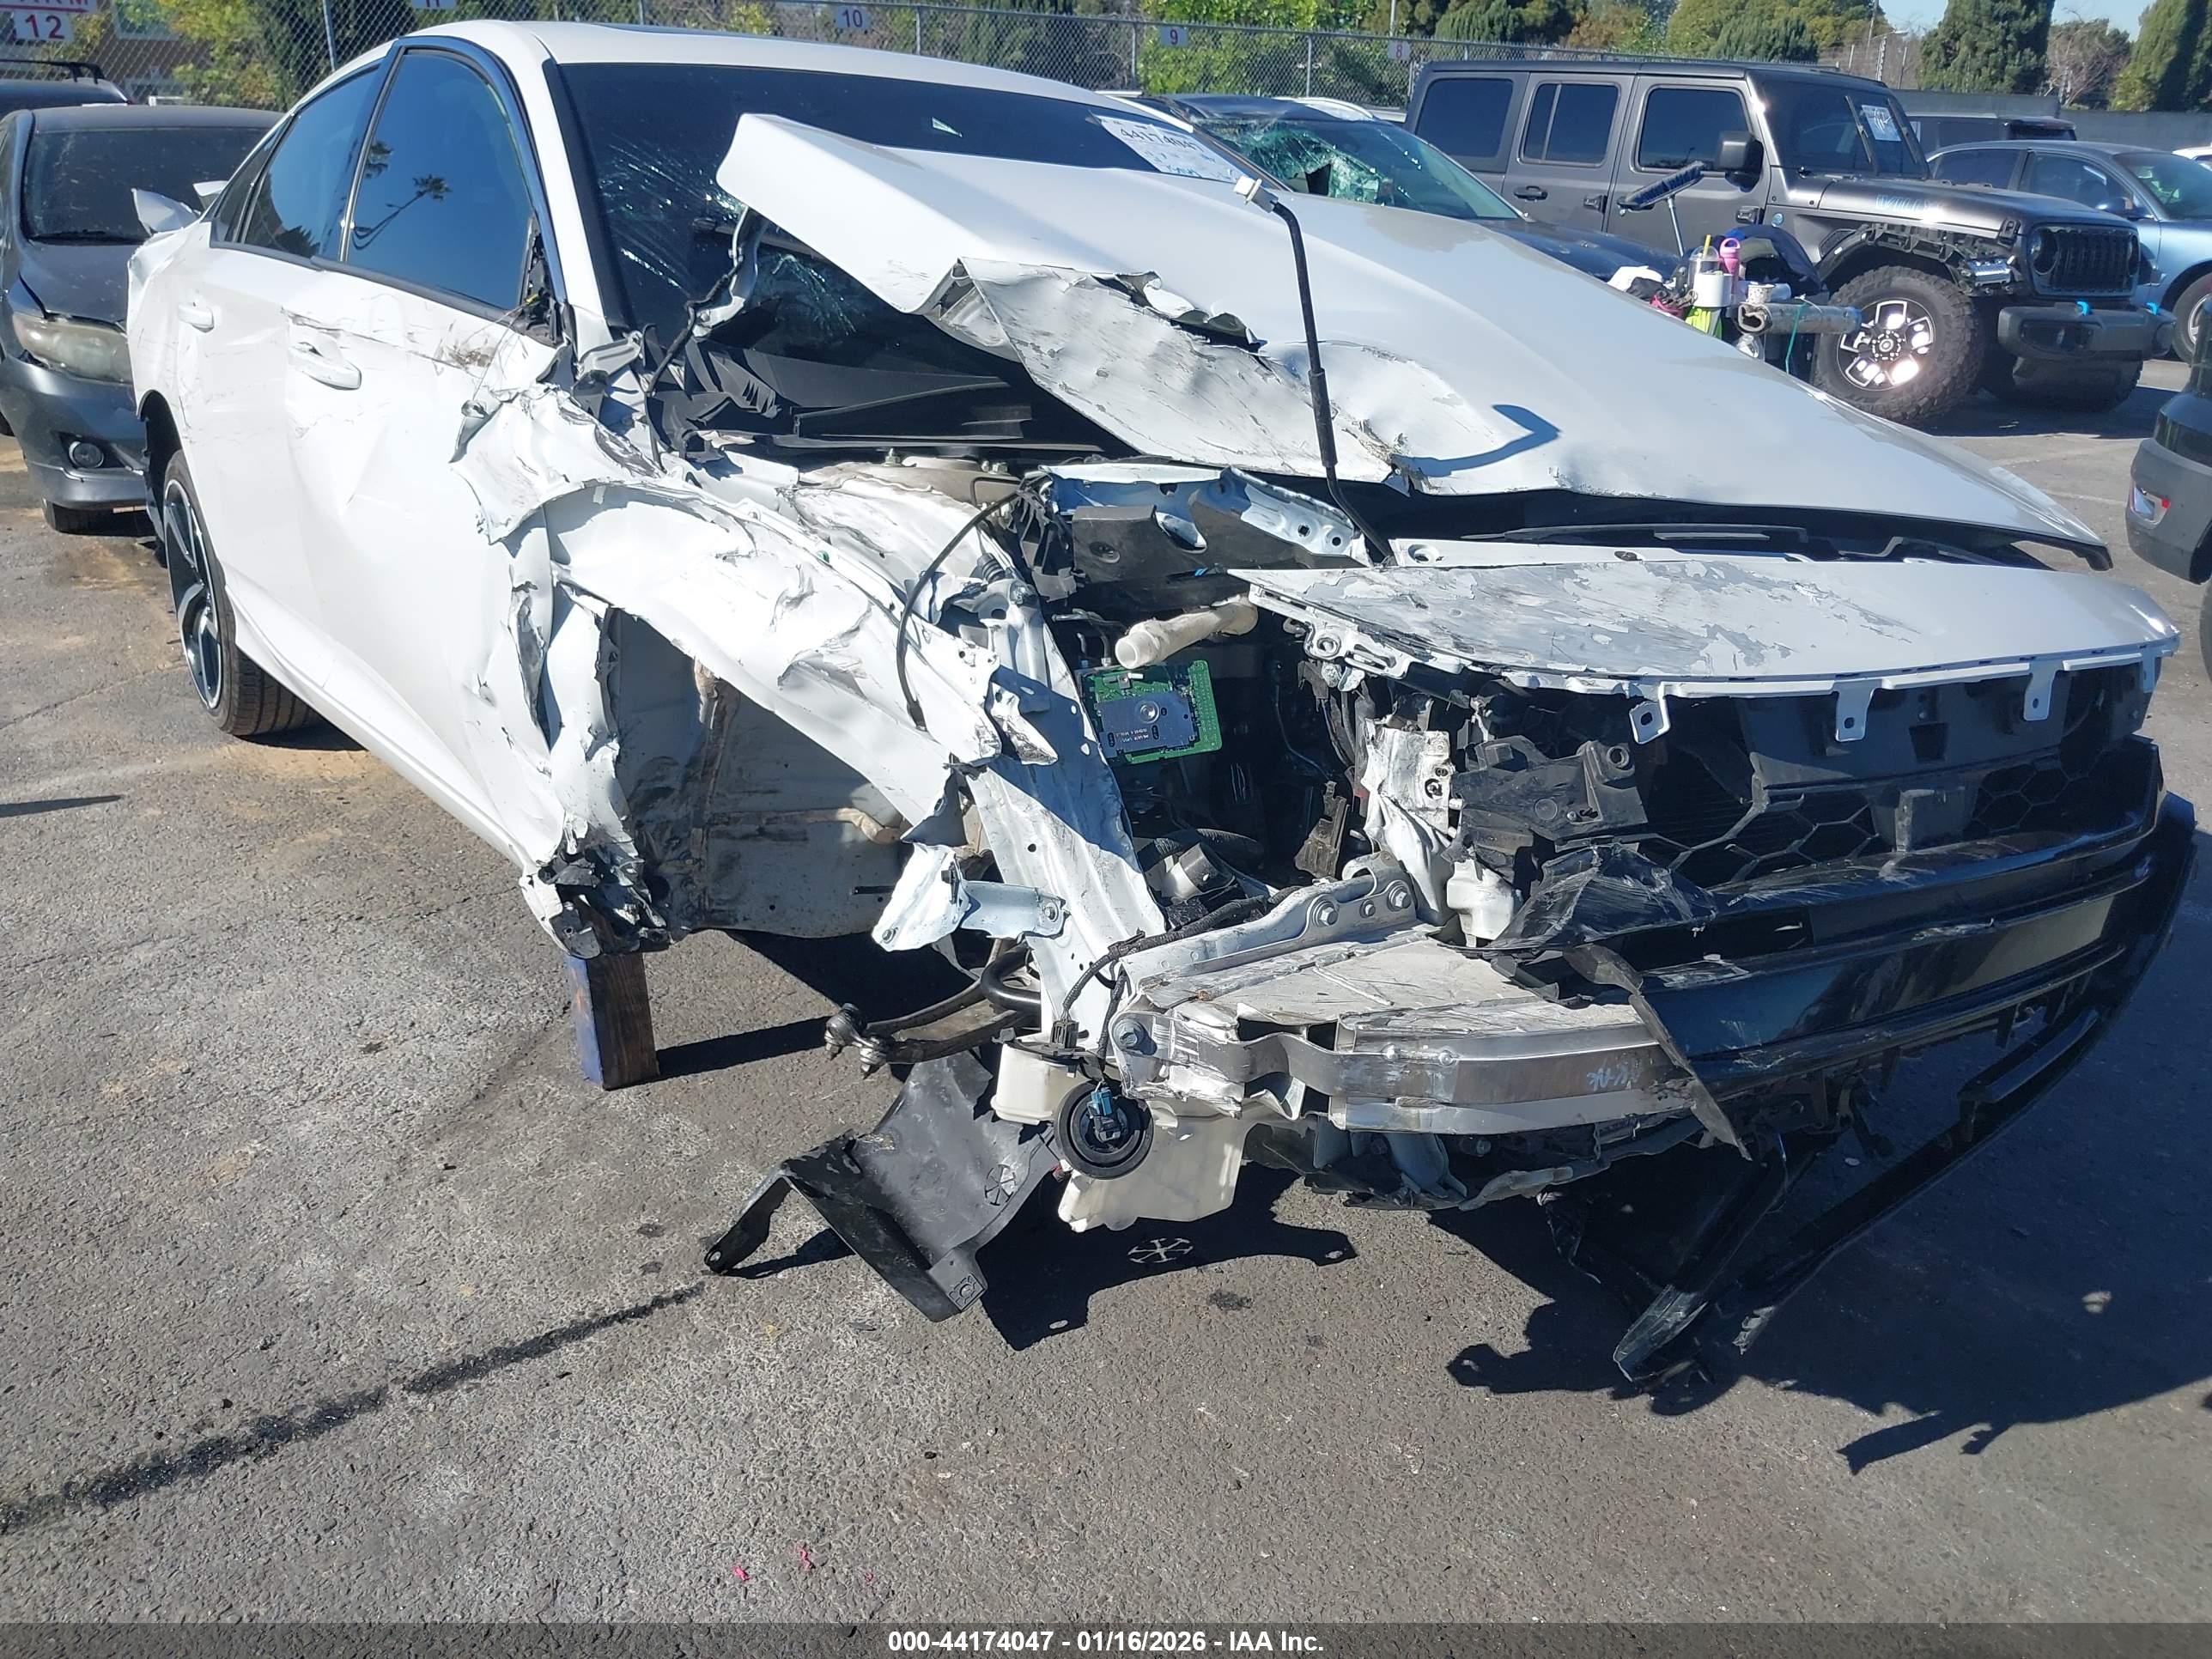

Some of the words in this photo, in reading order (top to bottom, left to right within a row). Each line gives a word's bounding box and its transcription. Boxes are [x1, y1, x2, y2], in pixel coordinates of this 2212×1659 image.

[25, 14, 65, 39] 12
[842, 9, 863, 27] 10
[1170, 28, 1178, 45] 9
[1395, 43, 1403, 58] 8
